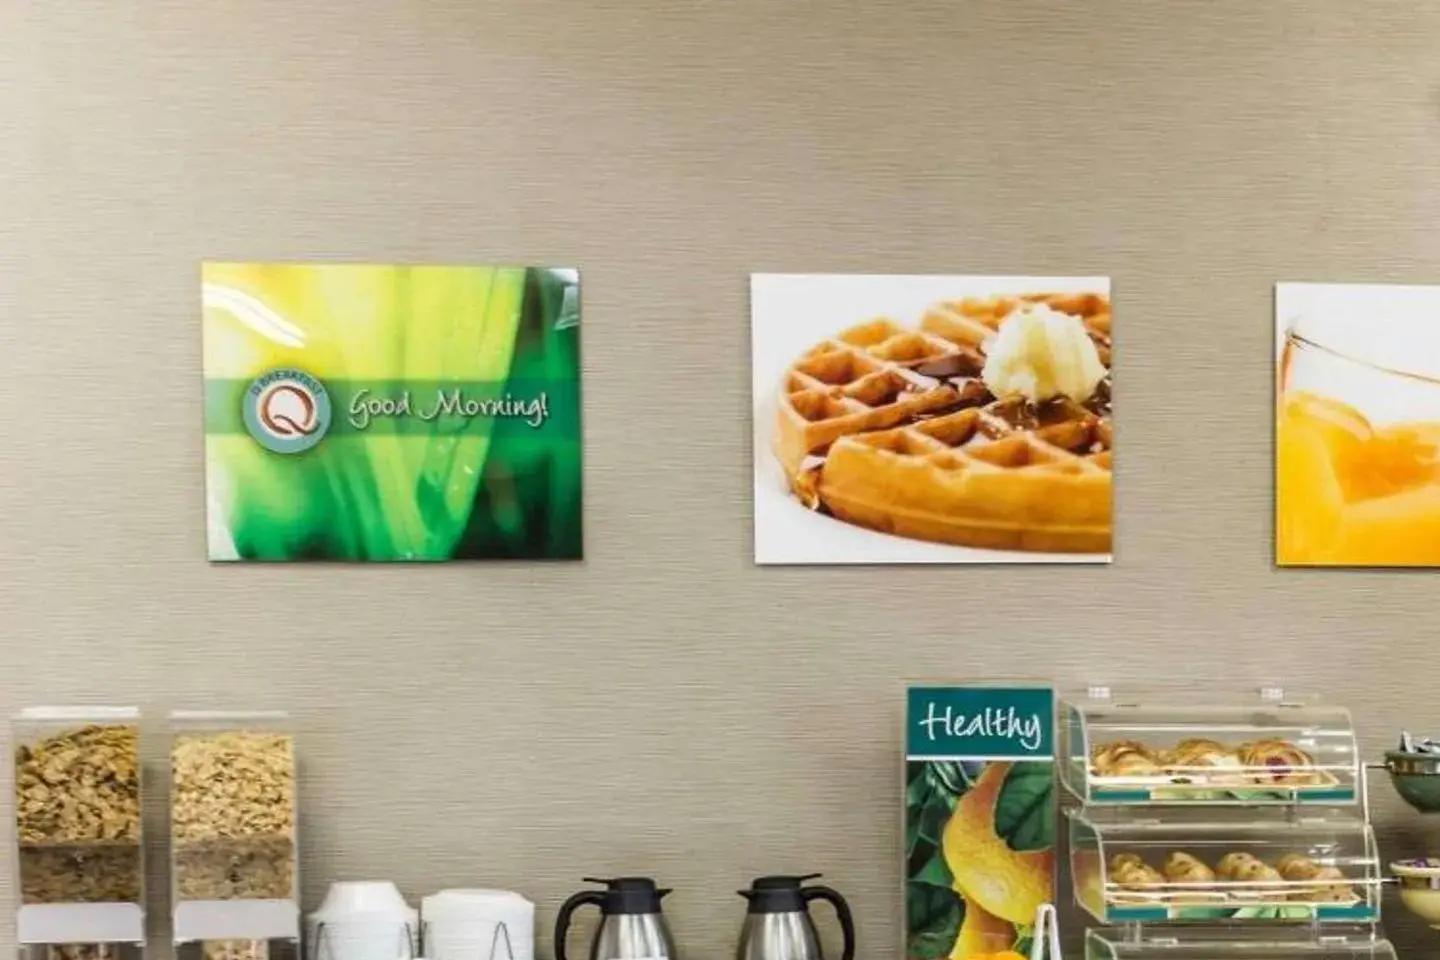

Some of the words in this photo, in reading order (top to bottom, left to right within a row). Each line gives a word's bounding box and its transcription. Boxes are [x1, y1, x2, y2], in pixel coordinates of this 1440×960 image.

[260, 385, 321, 436] Q
[350, 389, 412, 429] Good
[418, 388, 549, 427] Morning!
[918, 701, 1042, 750] Healthy
